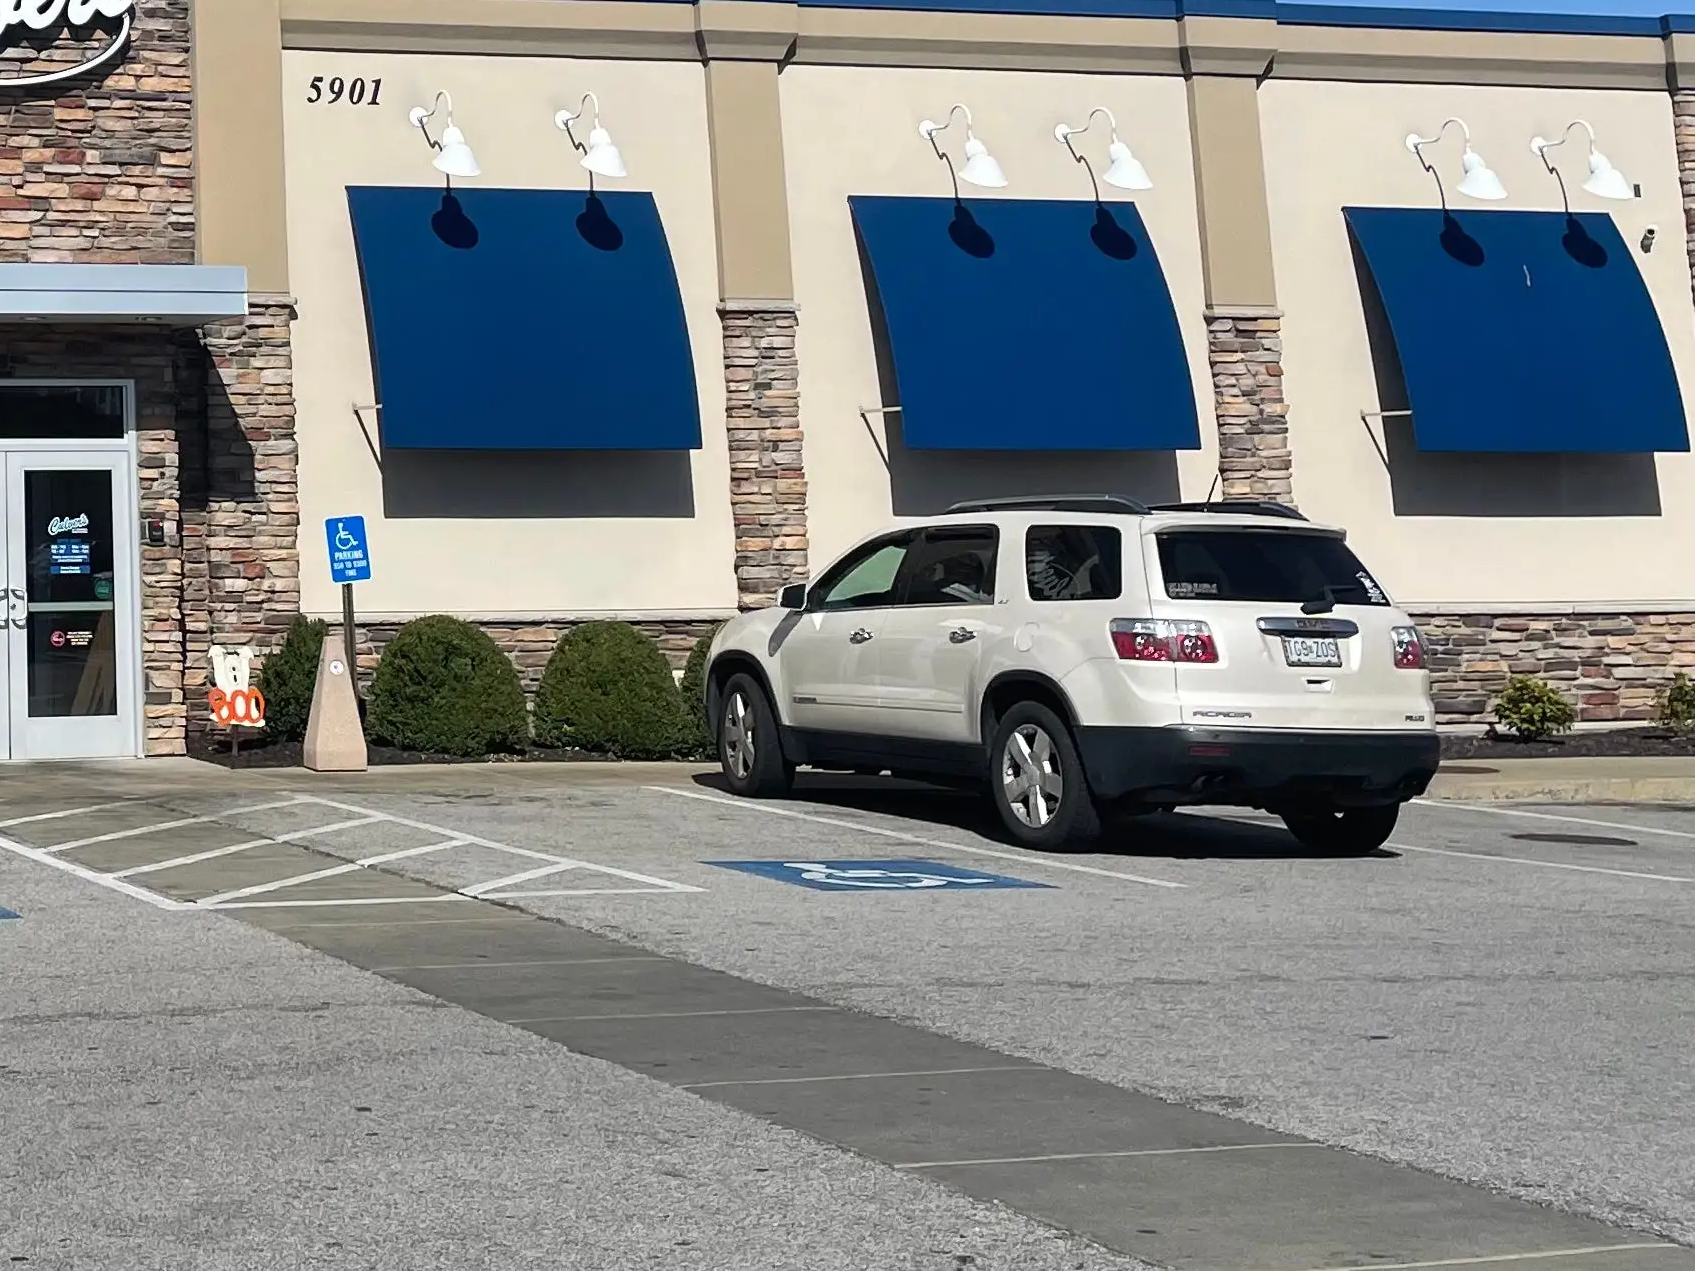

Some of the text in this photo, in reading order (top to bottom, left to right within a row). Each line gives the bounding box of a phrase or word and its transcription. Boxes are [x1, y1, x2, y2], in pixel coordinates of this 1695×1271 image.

[306, 76, 382, 105] 5901
[48, 513, 89, 535] Culver's
[334, 550, 364, 561] PARKING
[1285, 639, 1310, 658] TG9
[208, 686, 265, 726] BOO
